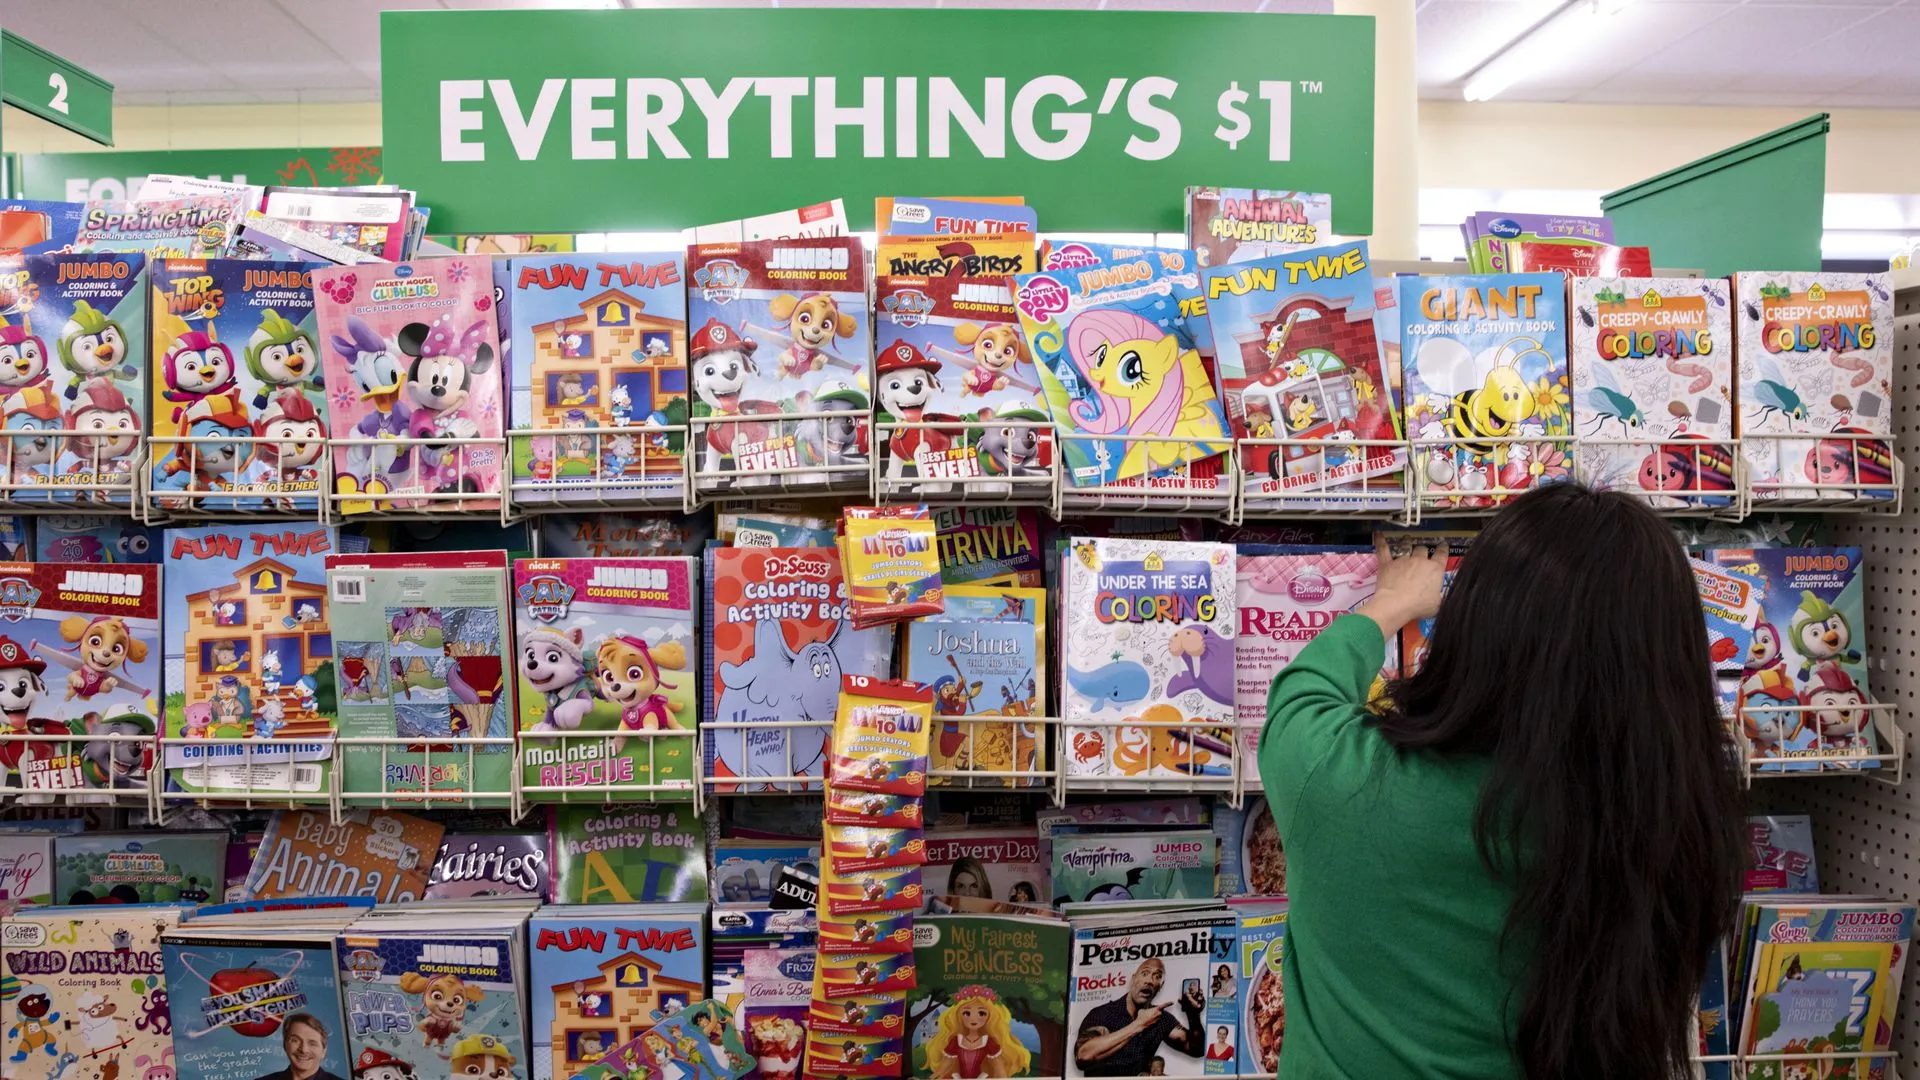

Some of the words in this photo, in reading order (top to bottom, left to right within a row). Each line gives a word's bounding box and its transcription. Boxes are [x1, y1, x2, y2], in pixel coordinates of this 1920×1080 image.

[48, 73, 69, 115] 2
[1211, 218, 1317, 244] ADVENTURES
[765, 247, 850, 270] JUMBO
[889, 256, 952, 278] ANGRY
[963, 254, 1023, 277] BIRDS
[57, 261, 130, 284] JUMBO
[243, 270, 312, 291] JUMBO
[517, 263, 589, 290] FUN
[596, 260, 681, 289] TIME
[693, 265, 751, 288] PAW
[767, 270, 818, 280] COLORING
[818, 271, 848, 281] BOOK
[1078, 261, 1152, 298] JUMBO
[1208, 267, 1277, 300] FUN
[1283, 248, 1367, 285] TIME
[68, 281, 111, 290] COLORING
[169, 275, 214, 296] TOP
[375, 278, 404, 288] MICKEY
[405, 276, 433, 286] MOUSE
[62, 289, 99, 297] ACTIVITY
[100, 289, 123, 297] BOOK
[255, 290, 299, 300] COLORING
[299, 291, 306, 299] &
[707, 289, 737, 299] PATROL
[1032, 287, 1054, 297] LITTLE
[163, 289, 225, 315] WING
[249, 298, 288, 307] ACTIVITY
[289, 299, 314, 308] BOOK
[356, 305, 371, 314] BIG
[372, 304, 389, 313] FUN
[390, 303, 414, 312] BOOK
[415, 302, 427, 310] TO
[428, 299, 459, 309] COLOR
[882, 294, 936, 315] PAW
[1018, 288, 1070, 324] PONY
[1420, 285, 1543, 322] GIANT
[895, 314, 924, 322] PATROL
[1600, 310, 1705, 328] CREEPY-CRAWLY
[1765, 304, 1869, 322] CREEPY-CRAWLY
[1407, 323, 1461, 335] COLORING
[1463, 323, 1471, 335] &
[1473, 321, 1523, 334] ACTIVITY
[1525, 320, 1556, 332] BOOK
[1596, 325, 1712, 361] COLORING
[1762, 320, 1876, 354] COLORING
[740, 443, 765, 456] BEST
[766, 435, 795, 451] PUPS
[739, 448, 800, 471] EVER!
[922, 451, 947, 465] BEST
[947, 446, 977, 462] PUPS
[922, 457, 981, 479] EVER!
[61, 537, 81, 545] Over
[170, 533, 243, 560] FUN
[249, 529, 331, 557] TIME
[749, 539, 772, 548] trees
[753, 533, 774, 542] save
[936, 519, 1033, 568] TRIVIA
[62, 545, 84, 559] 40
[887, 544, 907, 559] 10
[528, 560, 547, 571] nick
[547, 561, 561, 572] jr.
[1784, 555, 1849, 576] JUMBO
[58, 570, 144, 597] JUMBO
[586, 566, 669, 590] JUMBO
[1099, 574, 1148, 590] UNDER
[1150, 574, 1176, 590] THE
[1180, 574, 1208, 590] SEA
[1789, 581, 1823, 589] ACTIVITY
[1824, 580, 1845, 589] BOOK
[1795, 574, 1832, 582] COLORING
[517, 580, 576, 605] PAW
[587, 587, 637, 601] COLORING
[638, 589, 670, 602] BOOK
[744, 580, 831, 600] Coloring
[836, 581, 847, 599] &
[1293, 580, 1331, 596] Disney
[1715, 589, 1741, 604] Book
[59, 591, 110, 605] COLORING
[111, 595, 141, 607] BOOK
[1094, 590, 1217, 626] COLORING
[531, 605, 566, 615] PATROL
[927, 627, 1021, 656] Joshua
[1236, 646, 1264, 655] Reading
[1266, 646, 1278, 654] for
[1236, 654, 1289, 663] Understanding
[849, 675, 869, 688] 10
[1237, 679, 1267, 688] Sharpen
[1237, 687, 1267, 696] Reading
[876, 719, 897, 735] 10
[746, 729, 781, 747] HEARS
[27, 758, 50, 771] BEST
[51, 754, 81, 770] PUPS
[27, 767, 85, 790] EVER!
[540, 756, 634, 789] RESCUE
[378, 822, 396, 835] 30
[583, 812, 662, 833] Coloring
[666, 812, 678, 828] &
[294, 811, 354, 857] Baby
[568, 831, 647, 857] Activity
[651, 831, 696, 849] Book
[947, 842, 1004, 861] Every
[1005, 842, 1041, 862] Day
[1152, 842, 1203, 854] JUMBO
[776, 881, 818, 906] ADUL
[1837, 911, 1904, 926] JUMBO
[15, 931, 39, 940] trees
[18, 925, 39, 935] save
[913, 926, 934, 936] save
[950, 926, 976, 949] My
[980, 926, 1038, 950] Fairest
[1096, 930, 1110, 938] JOHN
[1241, 933, 1263, 943] BEST
[1265, 931, 1276, 940] OF
[1835, 926, 1879, 934] COLORING
[1879, 925, 1897, 933] AND
[536, 926, 608, 953] FUN
[613, 926, 697, 953] TIME
[1079, 931, 1236, 967] Personality
[6, 950, 67, 975] WILD
[69, 950, 165, 975] ANIMALS
[419, 963, 468, 977] COLORING
[468, 966, 498, 978] BOOK
[943, 948, 1045, 976] PRINCESS
[58, 978, 97, 989] Coloring
[100, 978, 122, 988] Book
[750, 982, 785, 998] Anna's
[788, 981, 813, 997] Bes
[1077, 971, 1127, 991] Rock's
[348, 990, 411, 1015] POWER
[352, 1011, 415, 1036] PUPS
[182, 1051, 208, 1063] Can
[212, 1050, 236, 1065] you
[240, 1047, 272, 1058] make
[197, 1059, 217, 1071] the
[222, 1056, 263, 1072] grade?
